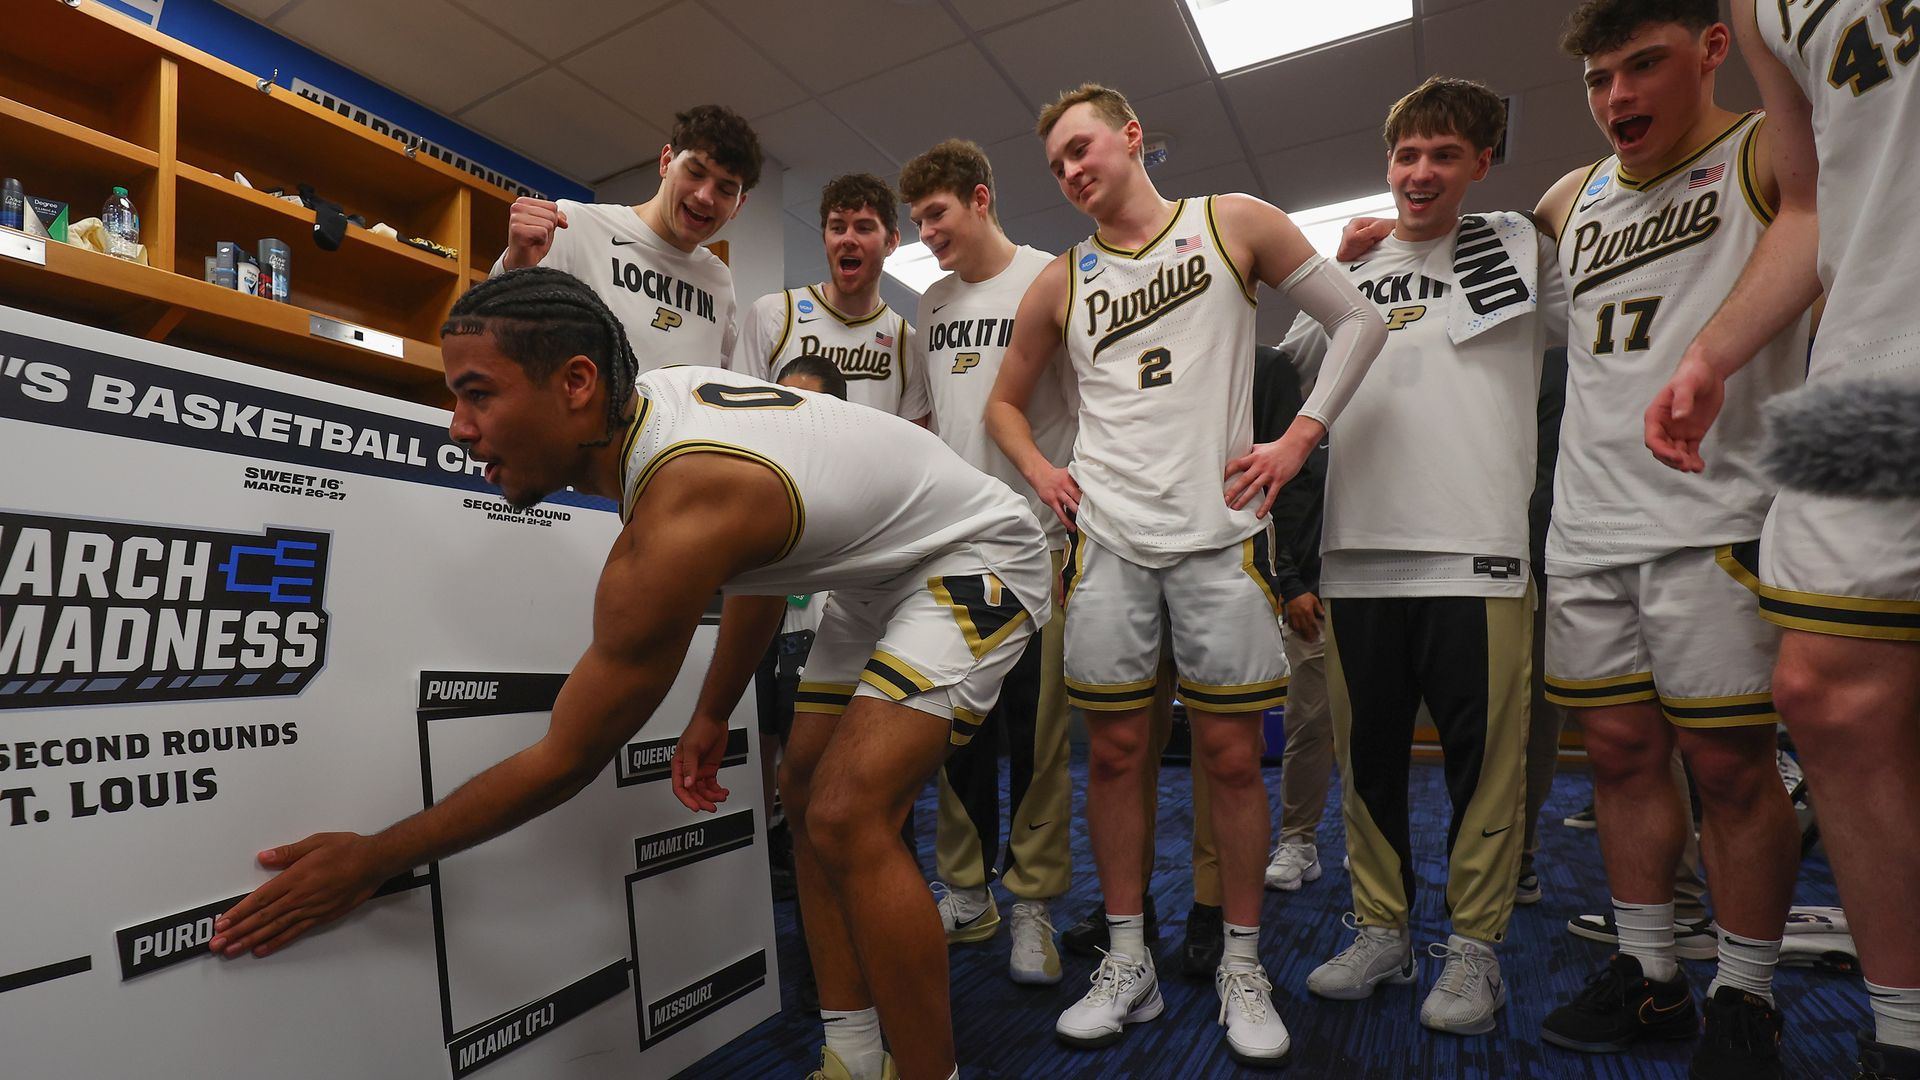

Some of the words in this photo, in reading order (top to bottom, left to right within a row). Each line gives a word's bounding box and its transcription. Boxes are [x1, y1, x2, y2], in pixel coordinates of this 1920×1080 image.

[1827, 0, 1920, 97] 45
[34, 199, 58, 209] Degree
[1569, 190, 1722, 277] Purdue
[612, 257, 673, 306] LOCK
[675, 279, 695, 312] IT
[696, 288, 716, 324] IN.
[1084, 254, 1213, 337] Purdue
[1357, 272, 1414, 305] OCK
[651, 306, 683, 331] P
[929, 320, 974, 352] LOCK
[974, 319, 998, 347] IT
[1592, 296, 1664, 356] 17
[951, 352, 981, 375] P
[1137, 346, 1173, 390] 2
[0, 354, 71, 403] 'S
[87, 374, 427, 467] BASKETBALL
[691, 382, 807, 411] 0
[243, 480, 303, 495] MARCH
[304, 488, 347, 501] 26-27
[244, 466, 317, 487] SWEET
[487, 512, 525, 524] MARCH
[527, 517, 553, 528] 21-22
[525, 508, 571, 521] ROUND
[0, 525, 212, 601] ARCH
[426, 680, 499, 700] PURDUE
[162, 722, 298, 756] ROUNDS
[69, 767, 218, 818] LOUIS
[640, 834, 682, 862] MIAMI
[684, 828, 705, 848] (FL)
[133, 913, 223, 966] PURD
[654, 982, 713, 1027] MISSOURI
[459, 1020, 521, 1070] MIAMI
[525, 1002, 555, 1036] (FL)
